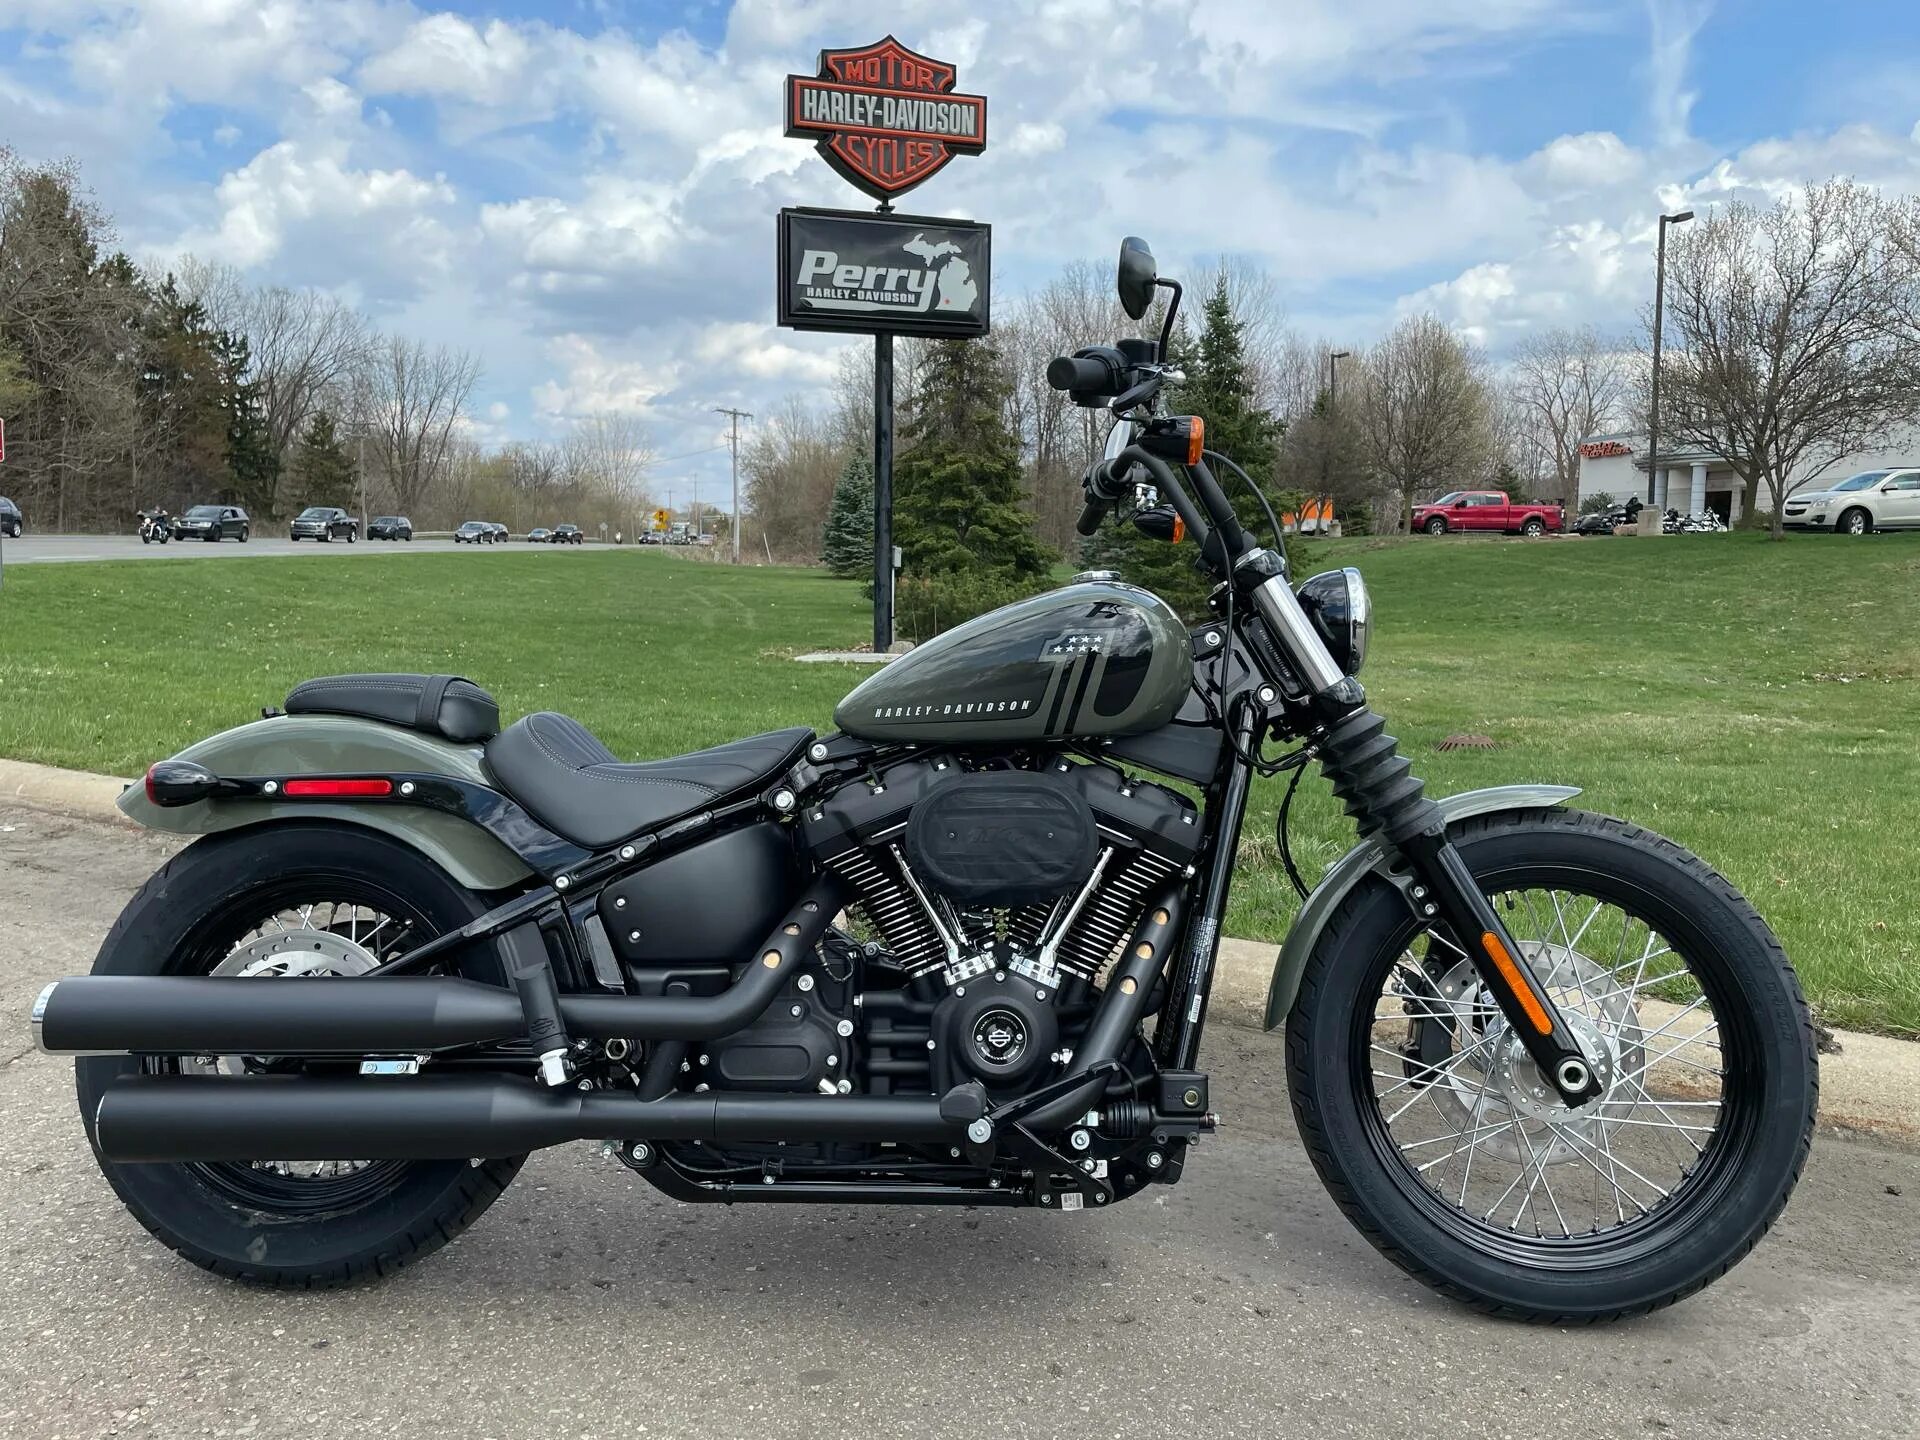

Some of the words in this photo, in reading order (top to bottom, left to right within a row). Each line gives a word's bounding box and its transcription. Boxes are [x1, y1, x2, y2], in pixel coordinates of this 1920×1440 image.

[845, 50, 935, 91] MOTOR
[804, 88, 975, 136] HARLEY-DAVIDSON
[847, 136, 934, 178] CYCLES
[797, 249, 938, 312] Perry
[875, 700, 1031, 718] HARLEY-DAVIDSON
